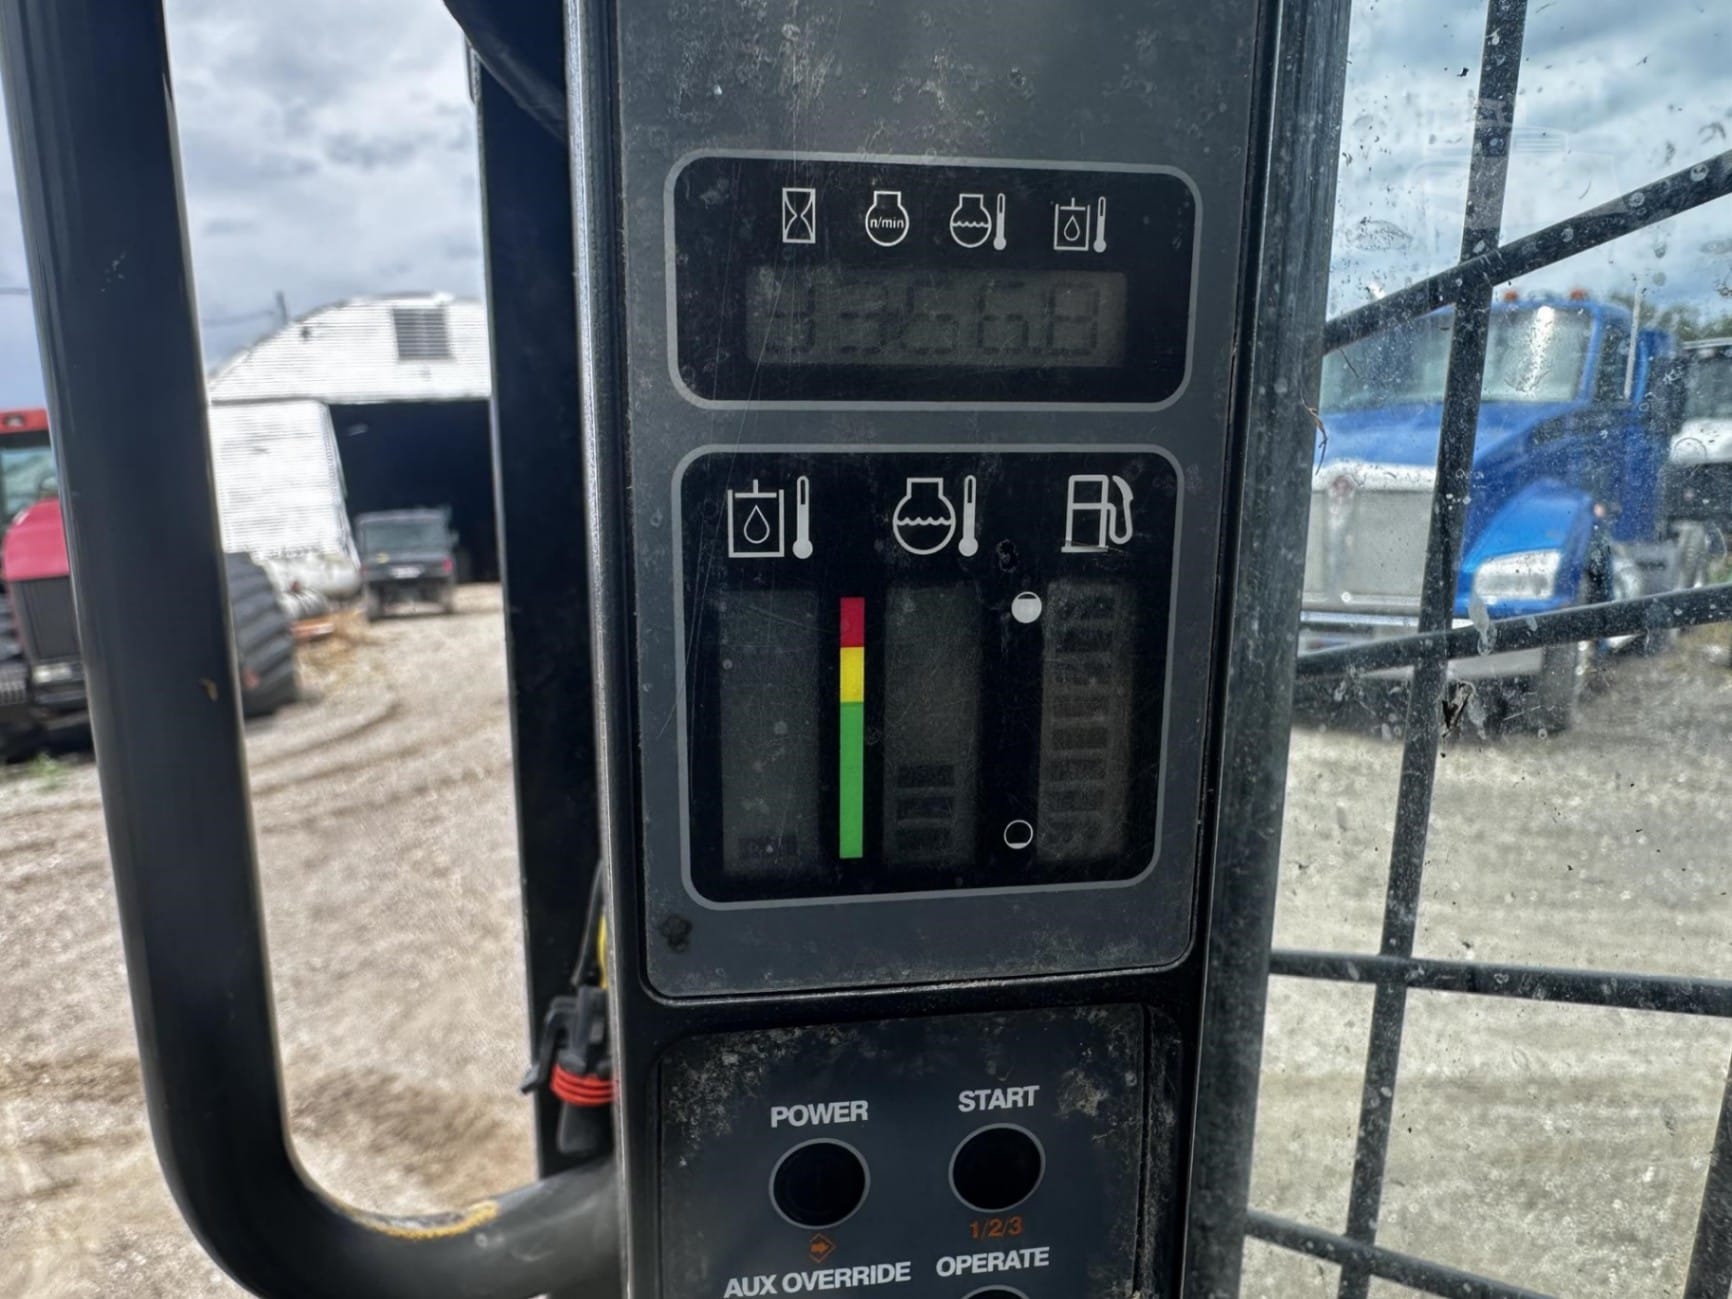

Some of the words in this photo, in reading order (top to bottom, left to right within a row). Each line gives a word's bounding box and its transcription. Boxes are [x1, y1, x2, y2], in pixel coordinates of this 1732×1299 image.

[869, 217, 905, 229] n/min
[958, 1085, 1040, 1112] START
[770, 1100, 869, 1128] POWER
[969, 1216, 1024, 1240] 1/2/3
[936, 1247, 1050, 1278] OPERATE
[723, 1274, 778, 1299] AUX
[782, 1262, 912, 1294] OVERRIDE
